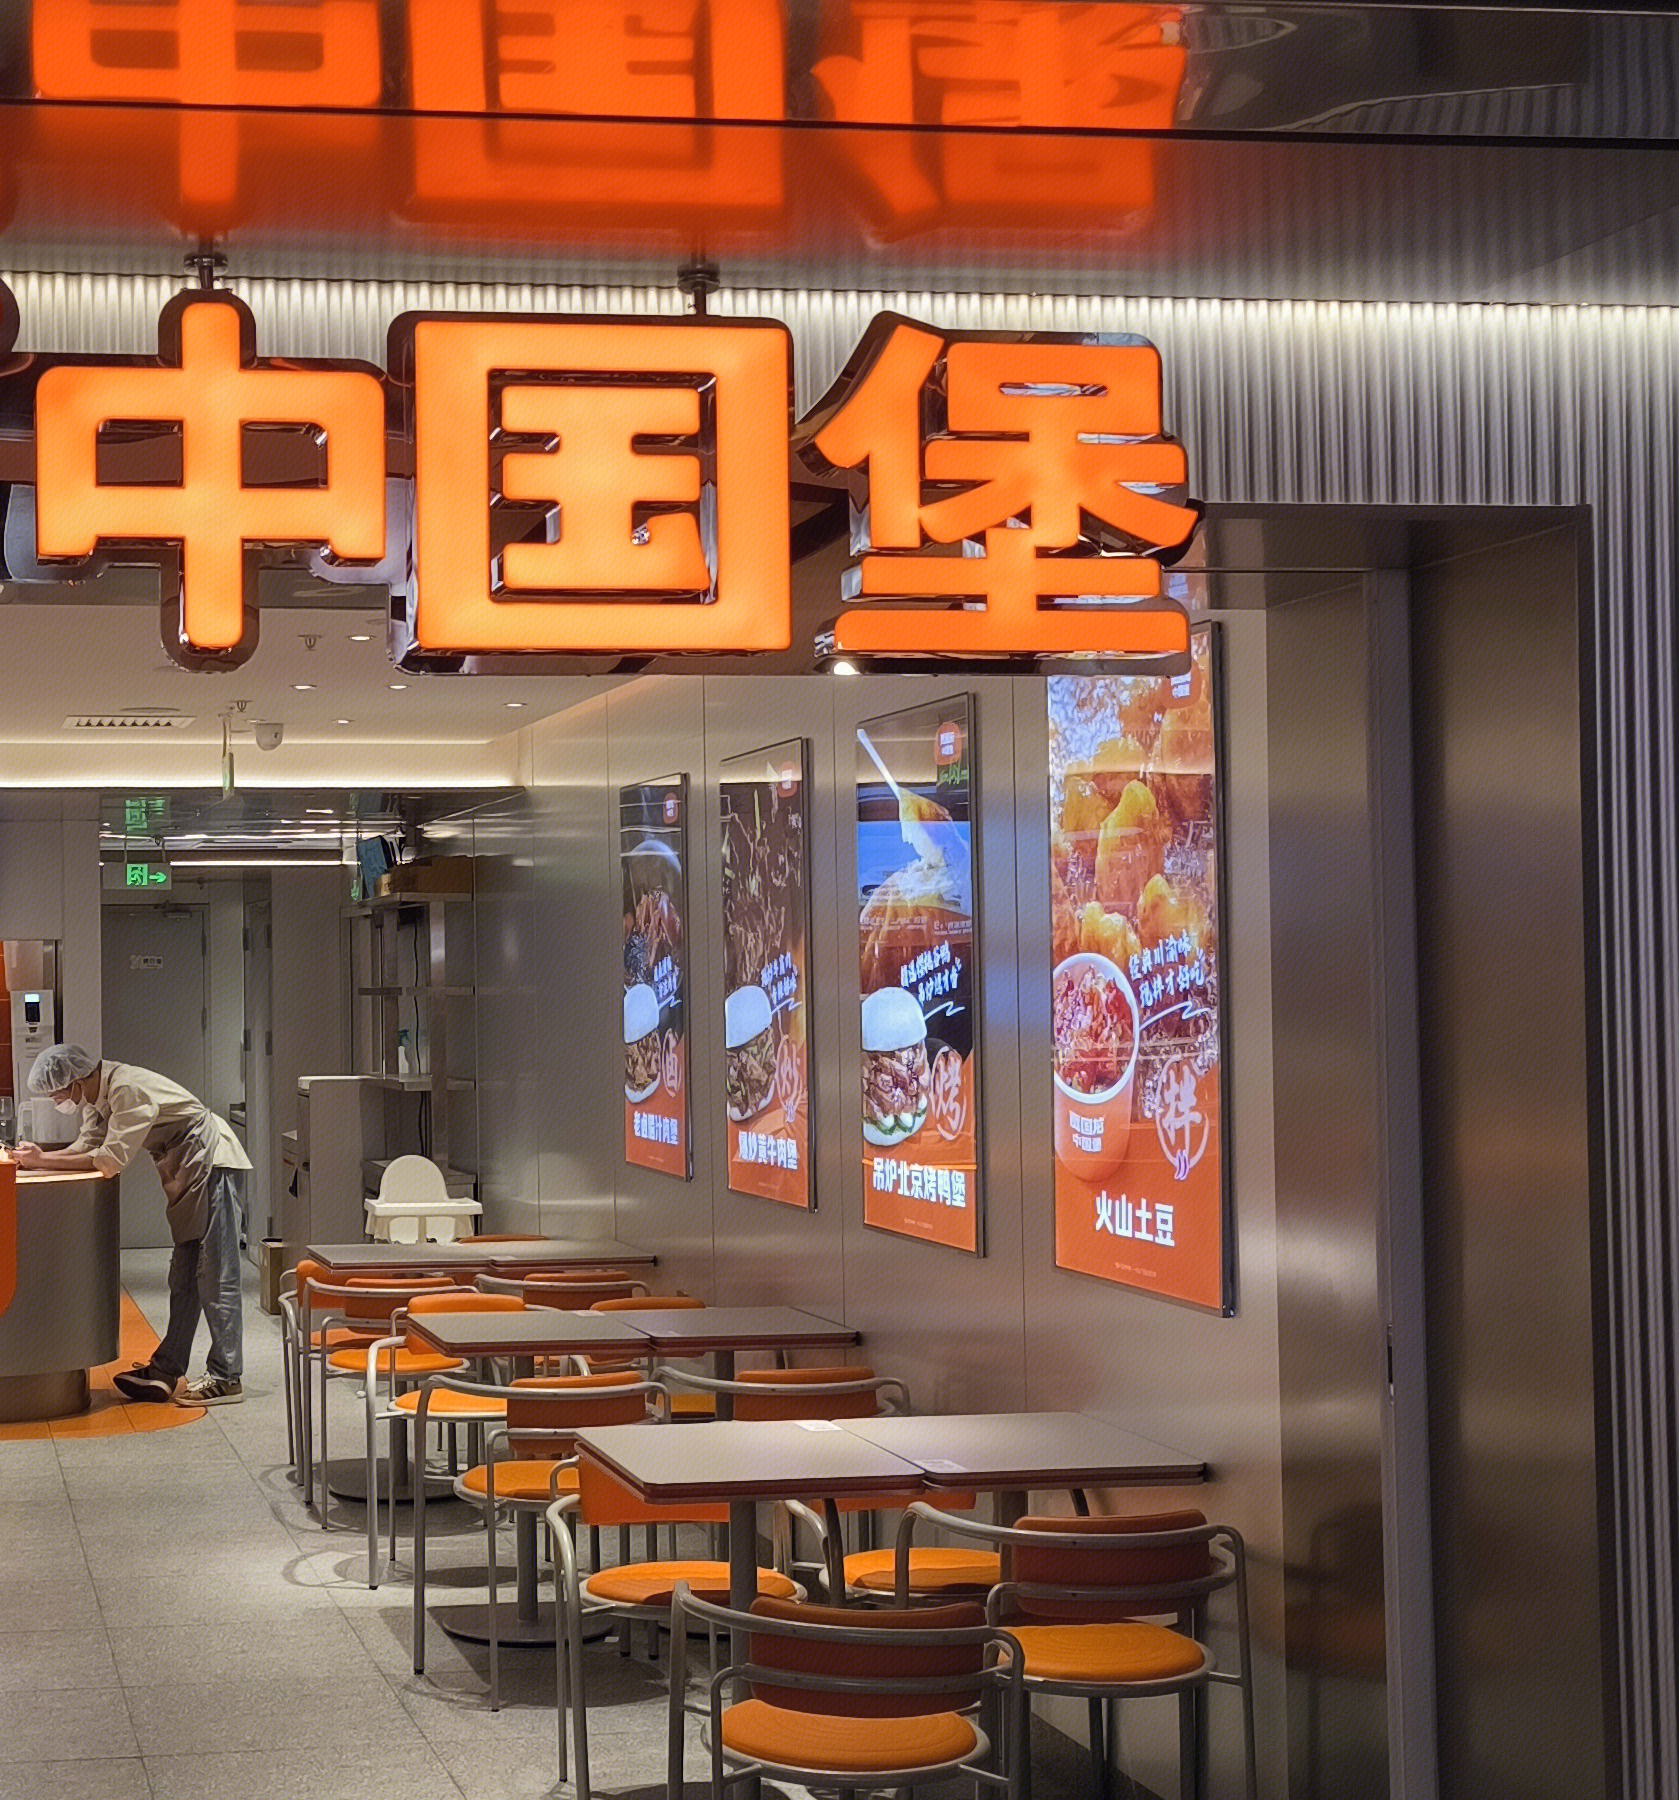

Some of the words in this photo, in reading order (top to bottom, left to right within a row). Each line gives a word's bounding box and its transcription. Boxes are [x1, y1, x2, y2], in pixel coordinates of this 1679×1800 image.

[36, 301, 1199, 652] 中国堡
[873, 1157, 966, 1208] 吊炉北京烤鸭堡
[1095, 1190, 1175, 1247] 火山土豆
